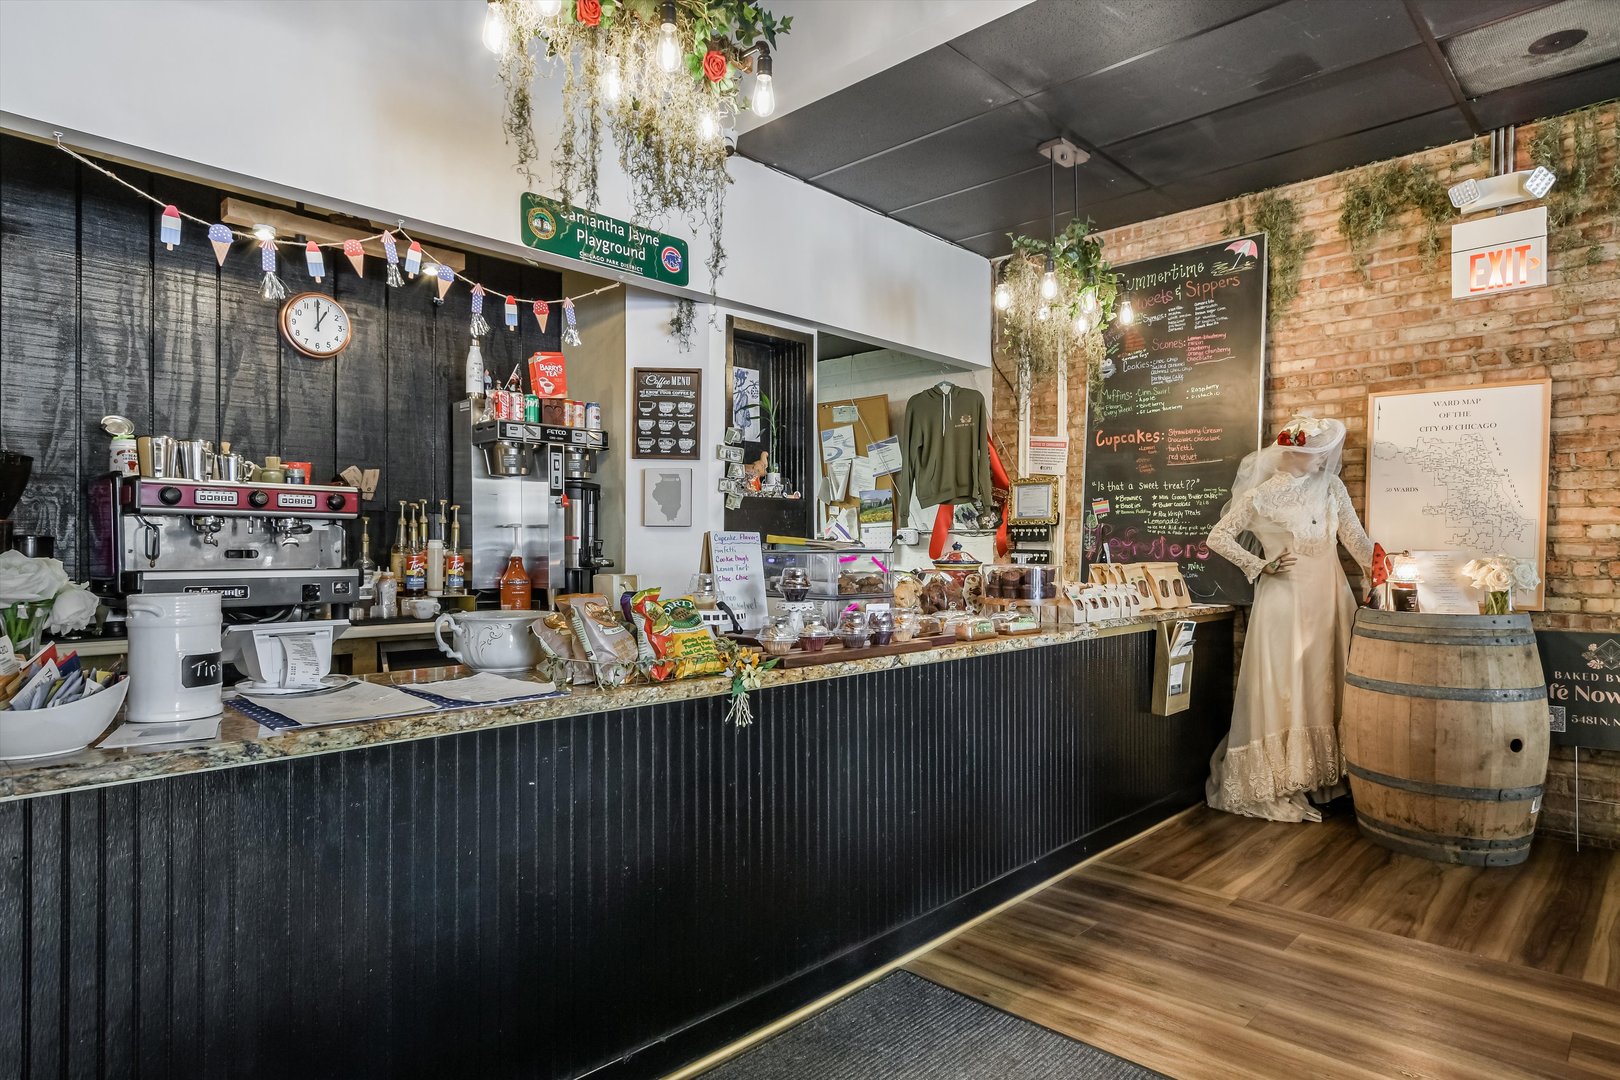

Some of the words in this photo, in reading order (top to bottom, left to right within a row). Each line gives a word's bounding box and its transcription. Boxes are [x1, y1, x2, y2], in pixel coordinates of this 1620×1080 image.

[560, 206, 625, 237] Samantha
[628, 219, 660, 247] Jayne
[576, 229, 646, 261] Playground
[579, 251, 605, 262] CHICAGO
[606, 258, 620, 267] PARK
[620, 262, 644, 272] DISTRICT
[1469, 244, 1532, 292] EXIT
[1133, 288, 1174, 312] weets
[1185, 275, 1241, 298] Sippers
[295, 329, 300, 337] 8
[1151, 338, 1186, 351] Scones:
[539, 363, 563, 373] BARRY'S
[1122, 360, 1152, 373] Cookies:
[646, 376, 671, 389] Coffee
[671, 376, 691, 386] MENU
[1101, 388, 1133, 400] Muffins:
[1462, 398, 1481, 406] MAP
[1439, 411, 1451, 419] OF
[1452, 410, 1471, 418] THE
[546, 428, 567, 436] FETCO
[1419, 425, 1439, 433] CITY
[1456, 422, 1498, 431] CHICAGO
[1095, 429, 1165, 452] Cupcakes:
[1168, 453, 1179, 461] red
[1107, 481, 1126, 492] that
[1138, 481, 1159, 490] sweet
[739, 534, 759, 542] Flavors
[716, 555, 734, 563] Cookie
[190, 660, 221, 678] Tips
[1554, 670, 1600, 682] BAKED
[1605, 674, 1620, 683] BY
[1600, 716, 1610, 727] N.
